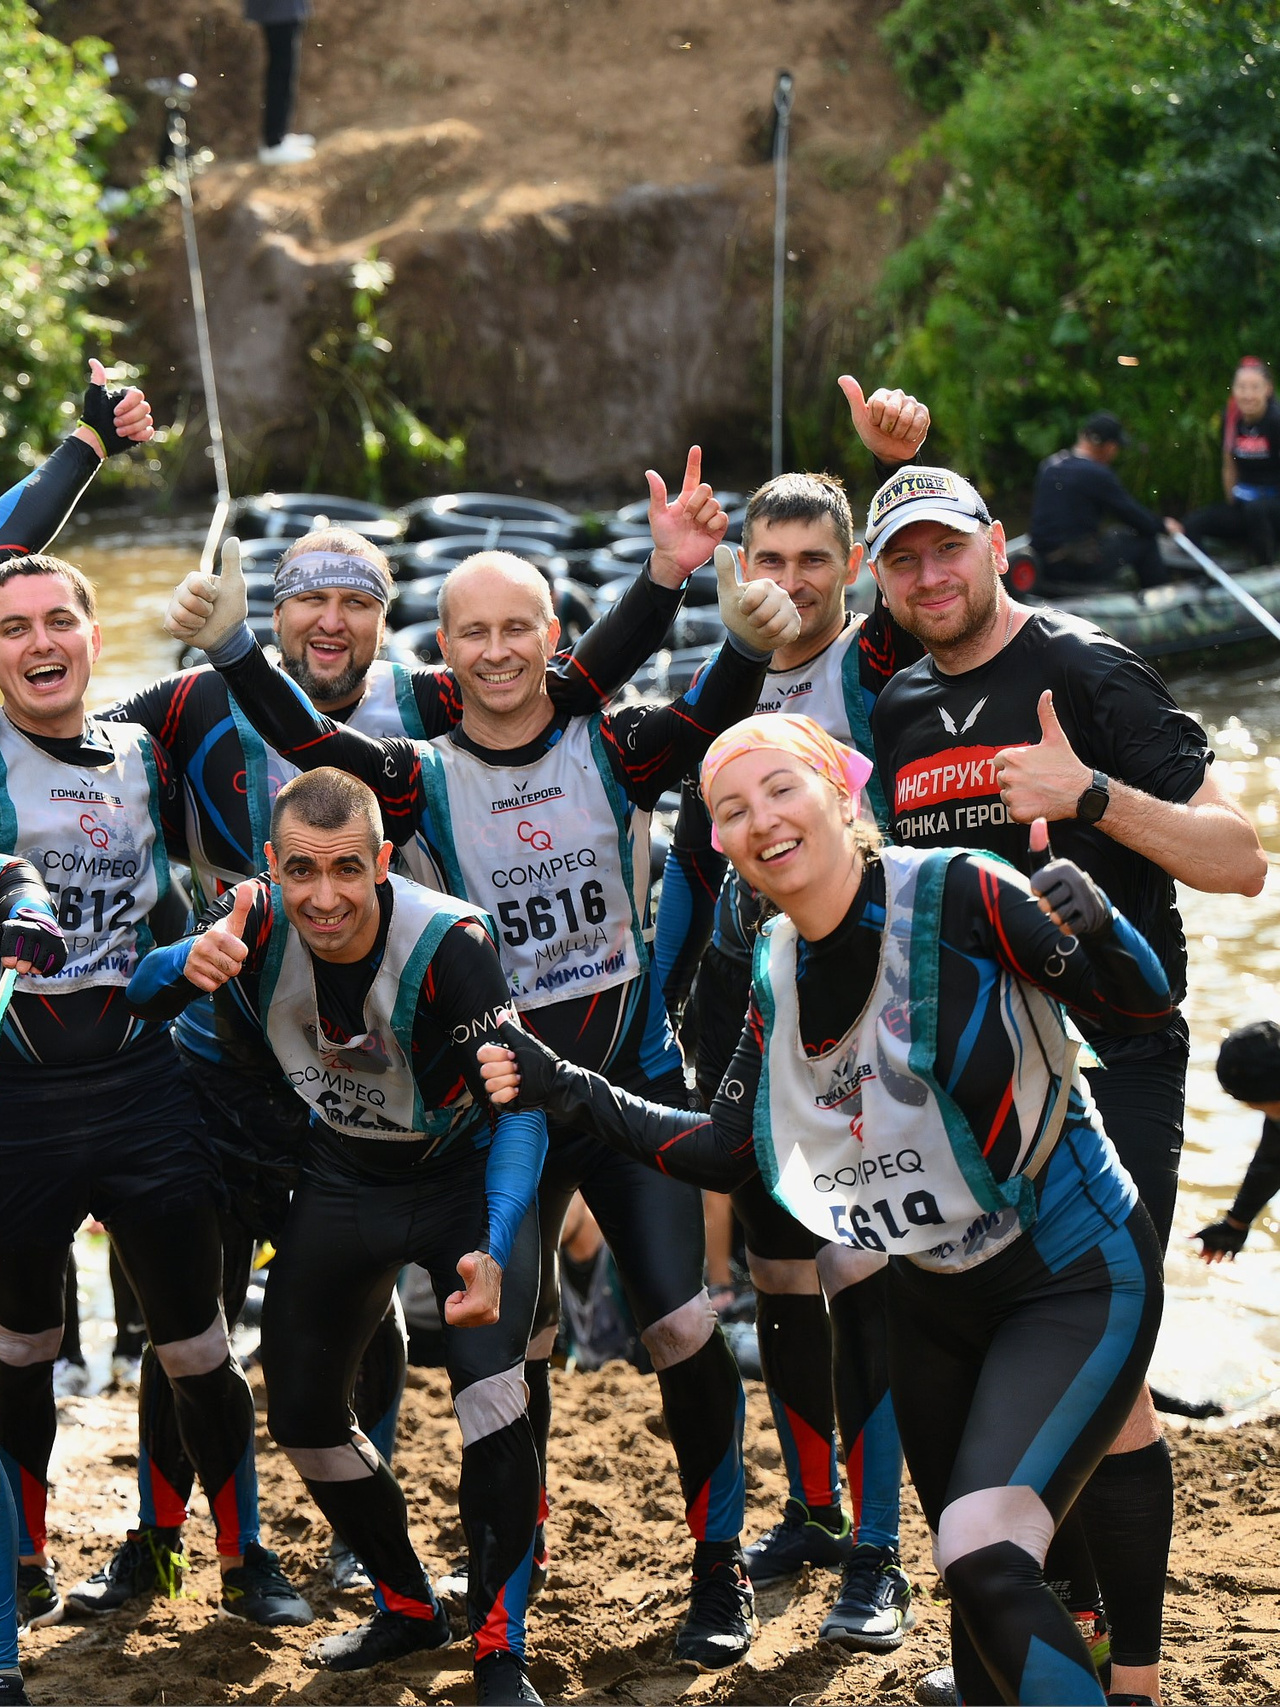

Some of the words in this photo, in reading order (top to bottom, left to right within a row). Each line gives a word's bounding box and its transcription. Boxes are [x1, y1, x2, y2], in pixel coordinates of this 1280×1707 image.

[50, 789, 86, 800] ГОНКА
[88, 791, 122, 805] ГЕРОЕВ
[491, 796, 521, 811] ГОНКА
[521, 786, 563, 805] ГЕРОЕВ
[43, 850, 137, 880] COMPEQ
[491, 848, 598, 889] COMPEQ
[497, 879, 608, 947] 5616
[535, 952, 626, 991] АММОНИЙ
[289, 1065, 386, 1110] COMPEQ
[828, 1189, 946, 1253] 5619
